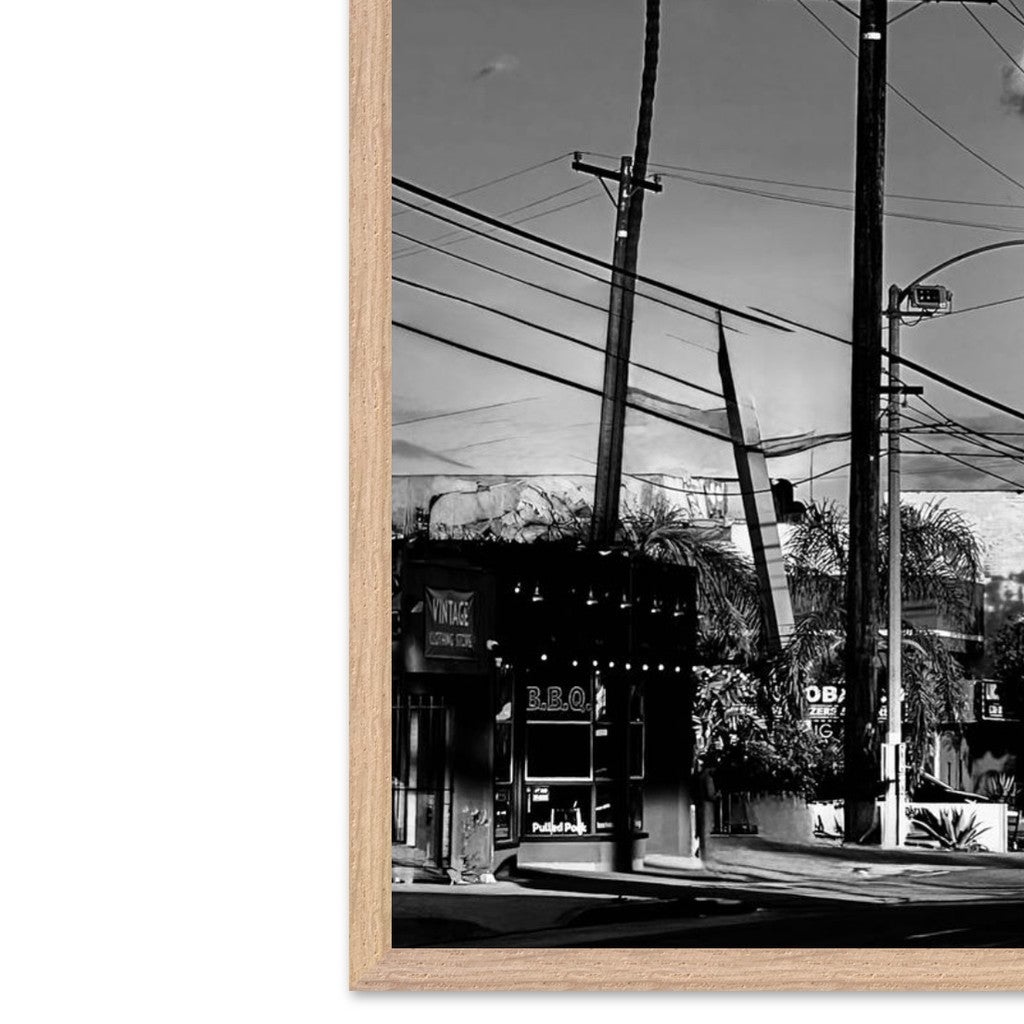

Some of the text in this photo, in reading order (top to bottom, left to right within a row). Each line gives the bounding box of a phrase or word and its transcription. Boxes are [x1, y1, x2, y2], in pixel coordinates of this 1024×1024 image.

[432, 598, 469, 626] VINTAGE
[526, 686, 592, 713] B.B.Q.
[564, 821, 587, 833] Pok
